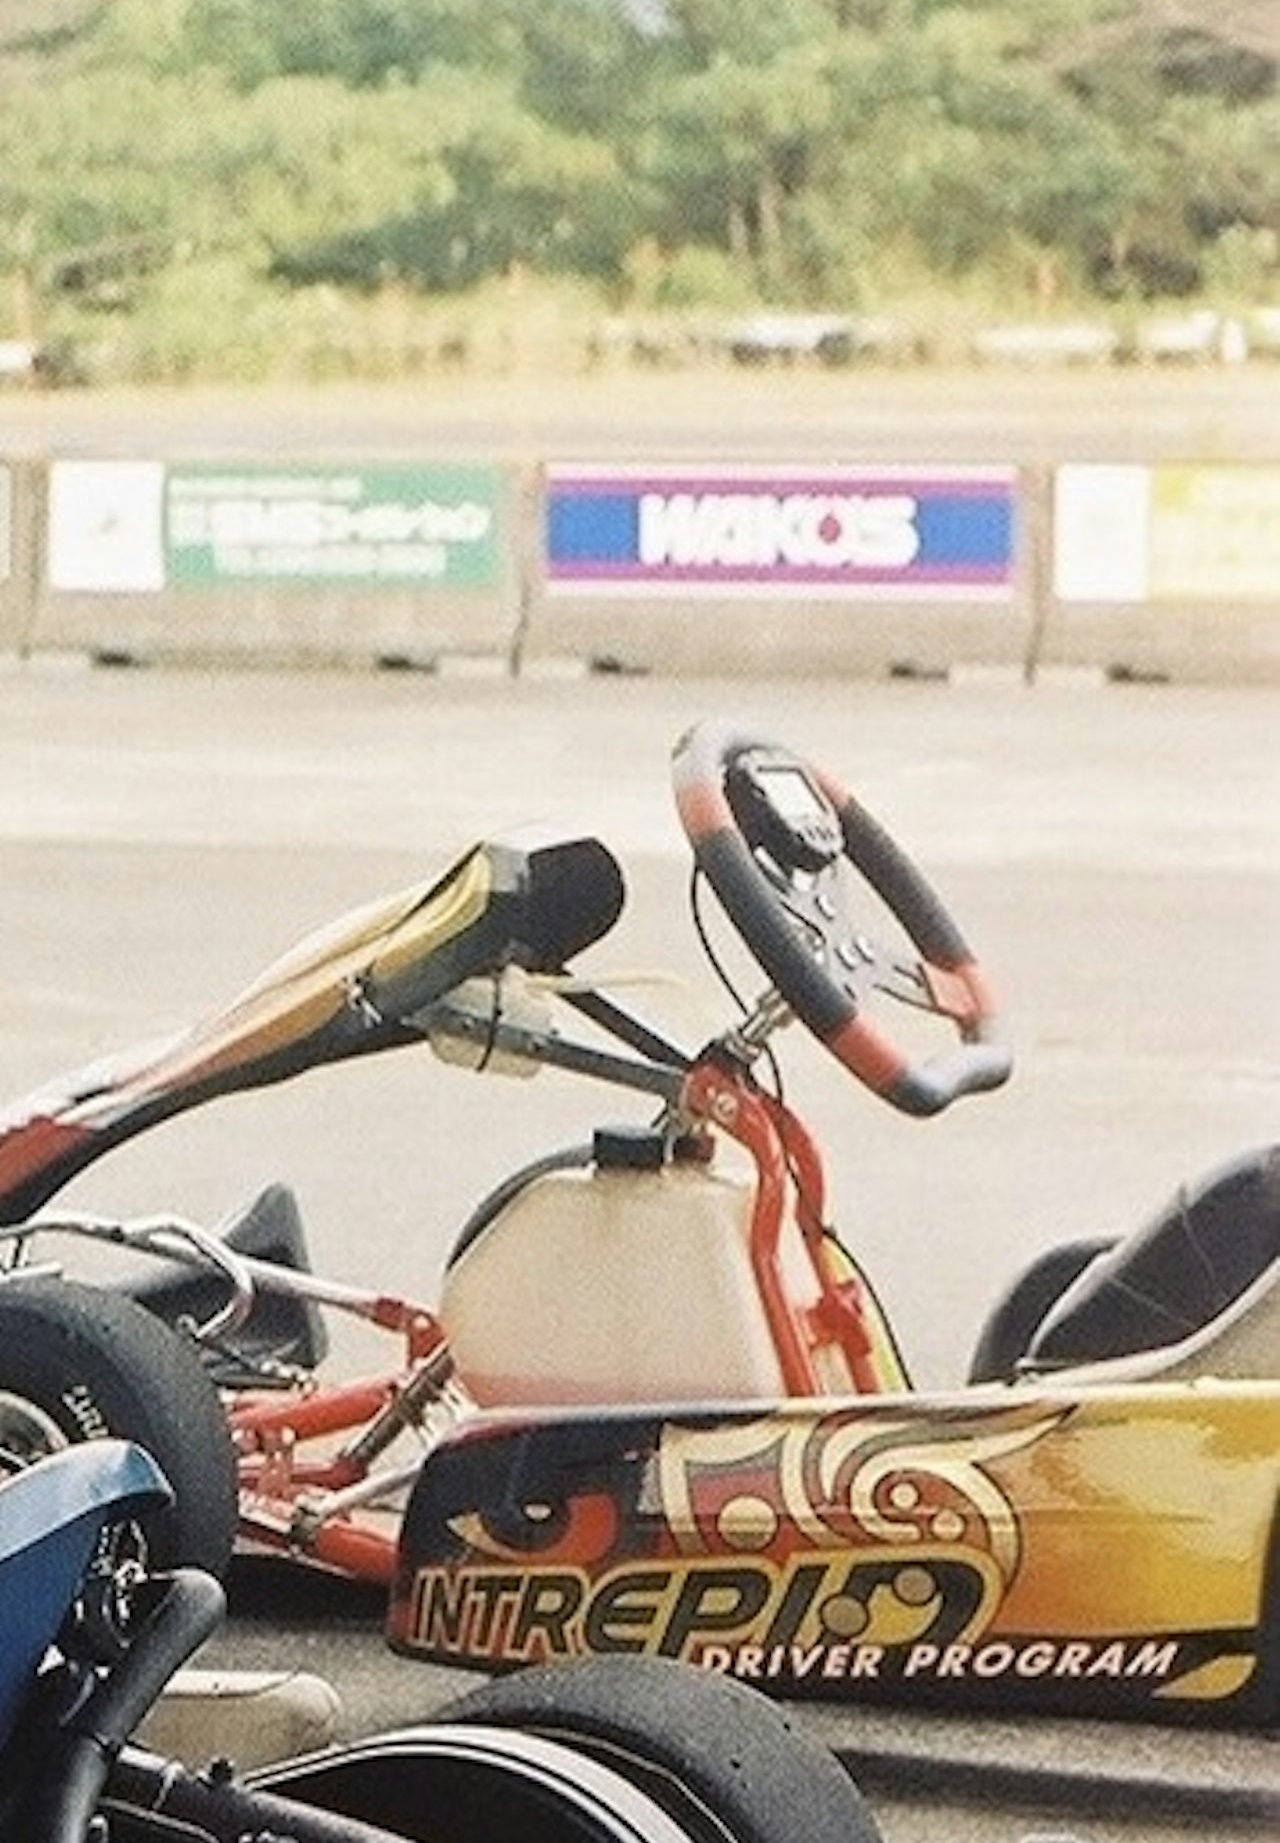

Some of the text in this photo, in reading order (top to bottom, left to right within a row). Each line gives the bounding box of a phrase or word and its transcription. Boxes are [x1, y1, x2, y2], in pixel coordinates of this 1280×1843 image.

[411, 1546, 996, 1661] INTREPID
[702, 1640, 1179, 1679] DRIVER PROGRAM
